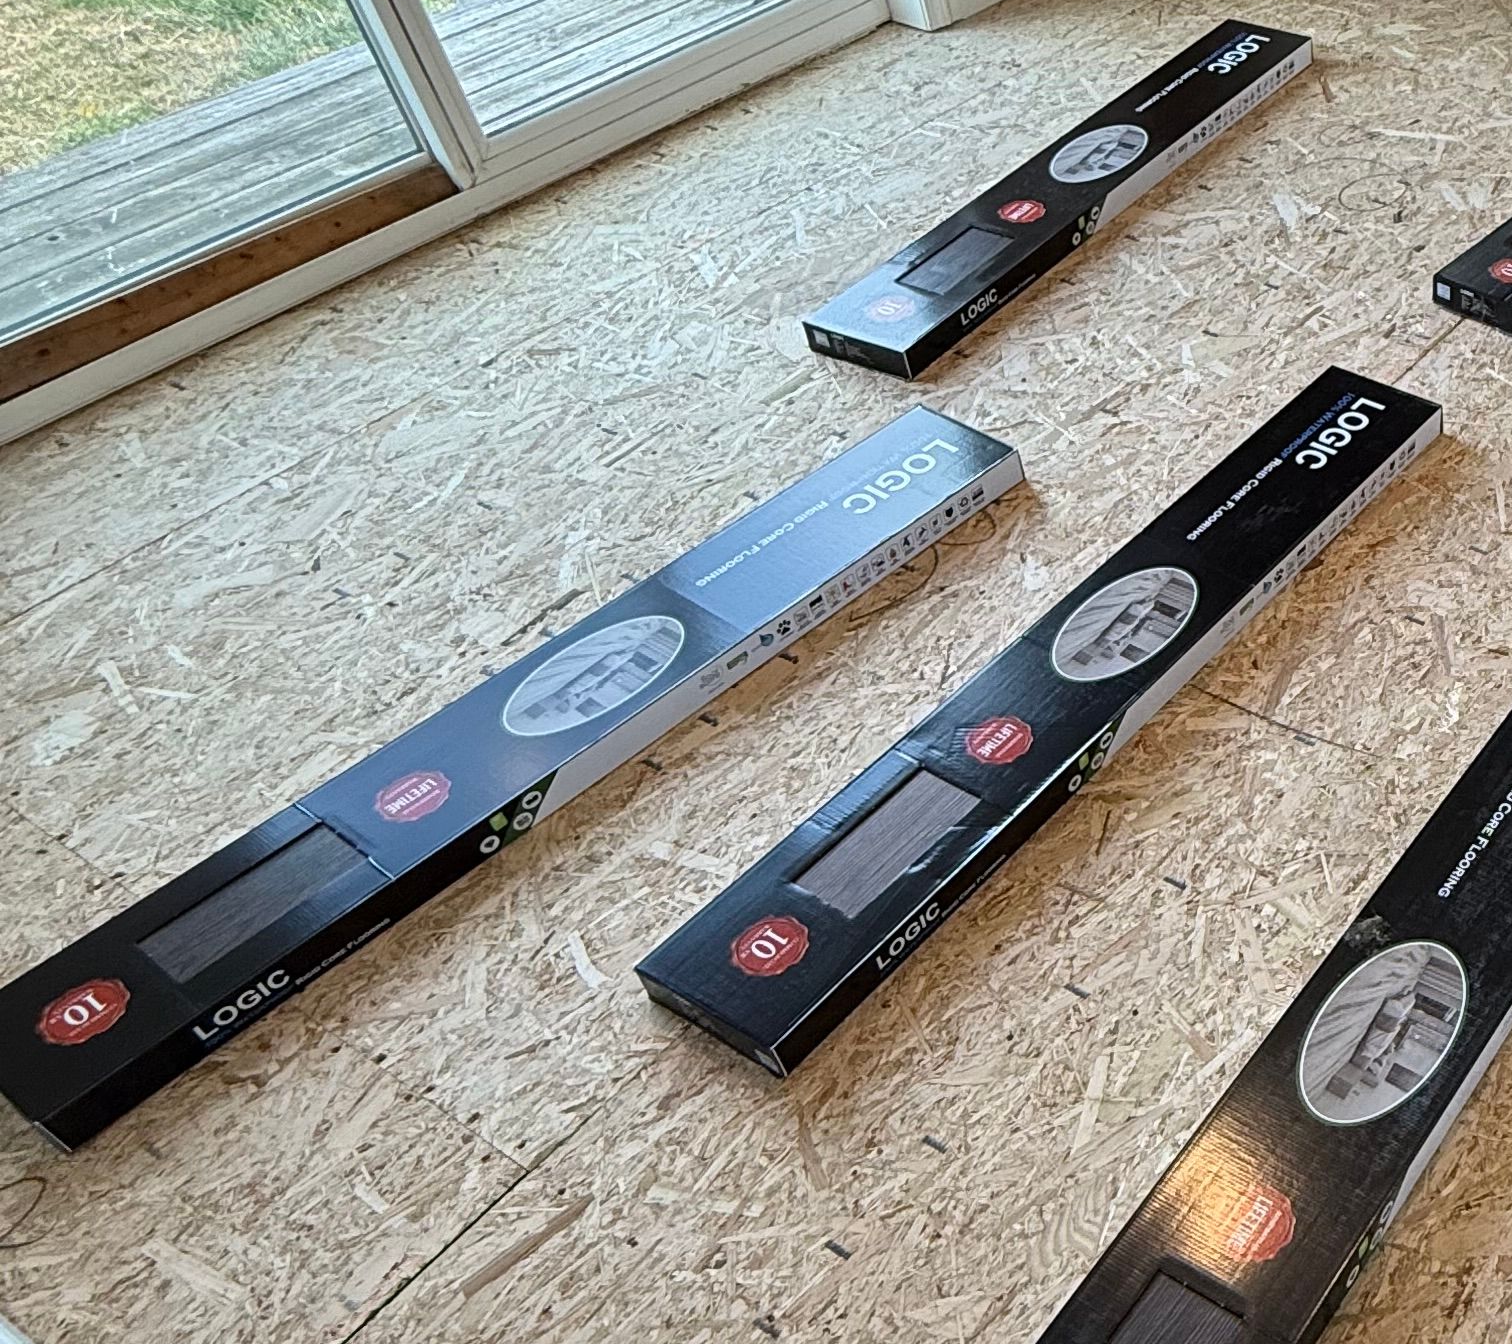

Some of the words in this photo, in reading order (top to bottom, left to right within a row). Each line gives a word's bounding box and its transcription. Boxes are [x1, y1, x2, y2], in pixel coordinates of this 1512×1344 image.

[1207, 34, 1271, 75] LOGIC
[877, 301, 902, 316] 10
[960, 288, 999, 326] LOGIC
[1295, 397, 1386, 470] LOGIC
[842, 438, 959, 514] LOGIC
[1231, 478, 1259, 502] CORE
[758, 522, 796, 547] CORE
[1186, 500, 1235, 541] FLOORING
[695, 543, 761, 587] FLOORING
[976, 723, 1018, 757] LIFETIME
[384, 778, 437, 814] LIFETIME
[1481, 802, 1512, 837] CORE
[1438, 835, 1489, 898] FLOORING
[751, 928, 789, 958] 10
[876, 902, 940, 970] LOGIC
[63, 992, 107, 1026] 10
[192, 969, 290, 1041] LOGIC
[1226, 1195, 1273, 1262] LIFETIME
